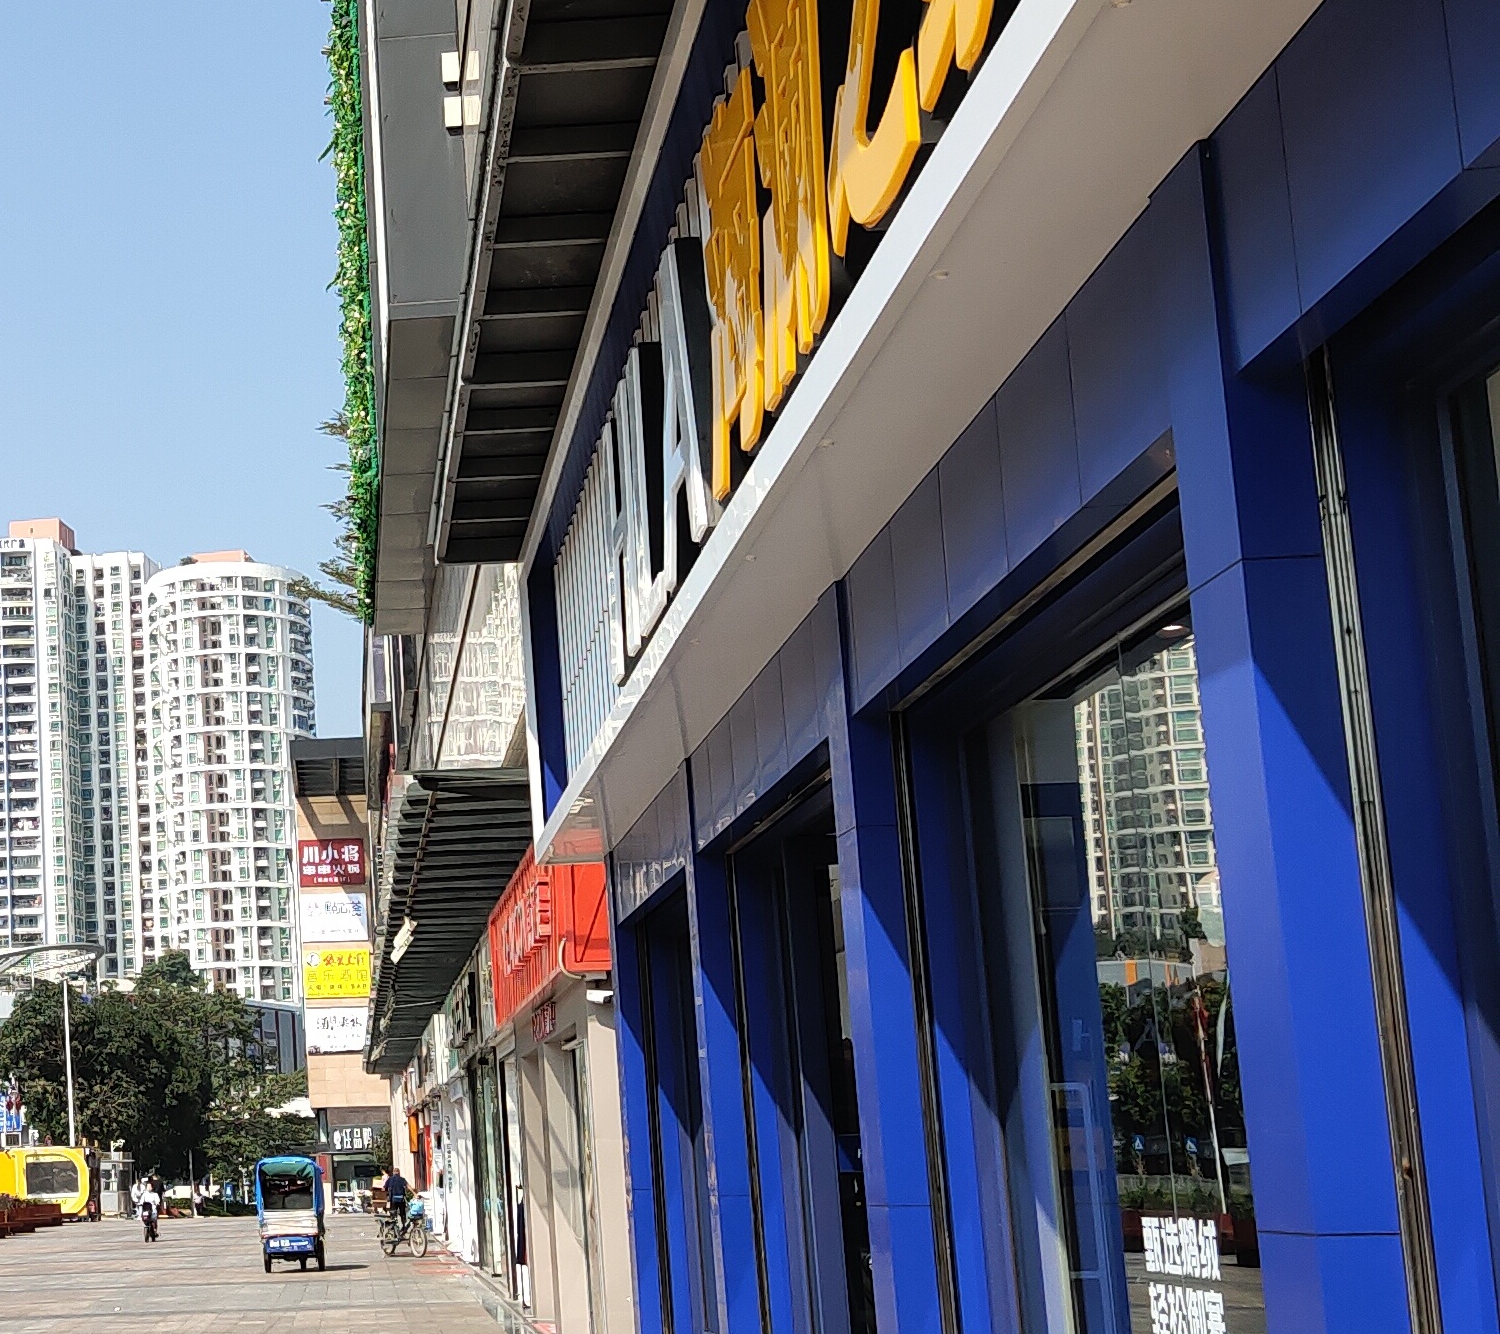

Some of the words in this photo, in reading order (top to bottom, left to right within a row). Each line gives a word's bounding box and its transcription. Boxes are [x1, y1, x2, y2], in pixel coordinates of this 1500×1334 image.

[601, 241, 708, 685] HLA
[302, 841, 360, 864] 川小将
[302, 864, 360, 876] 串串火锅
[1141, 1216, 1221, 1281] 甄选鹅绒
